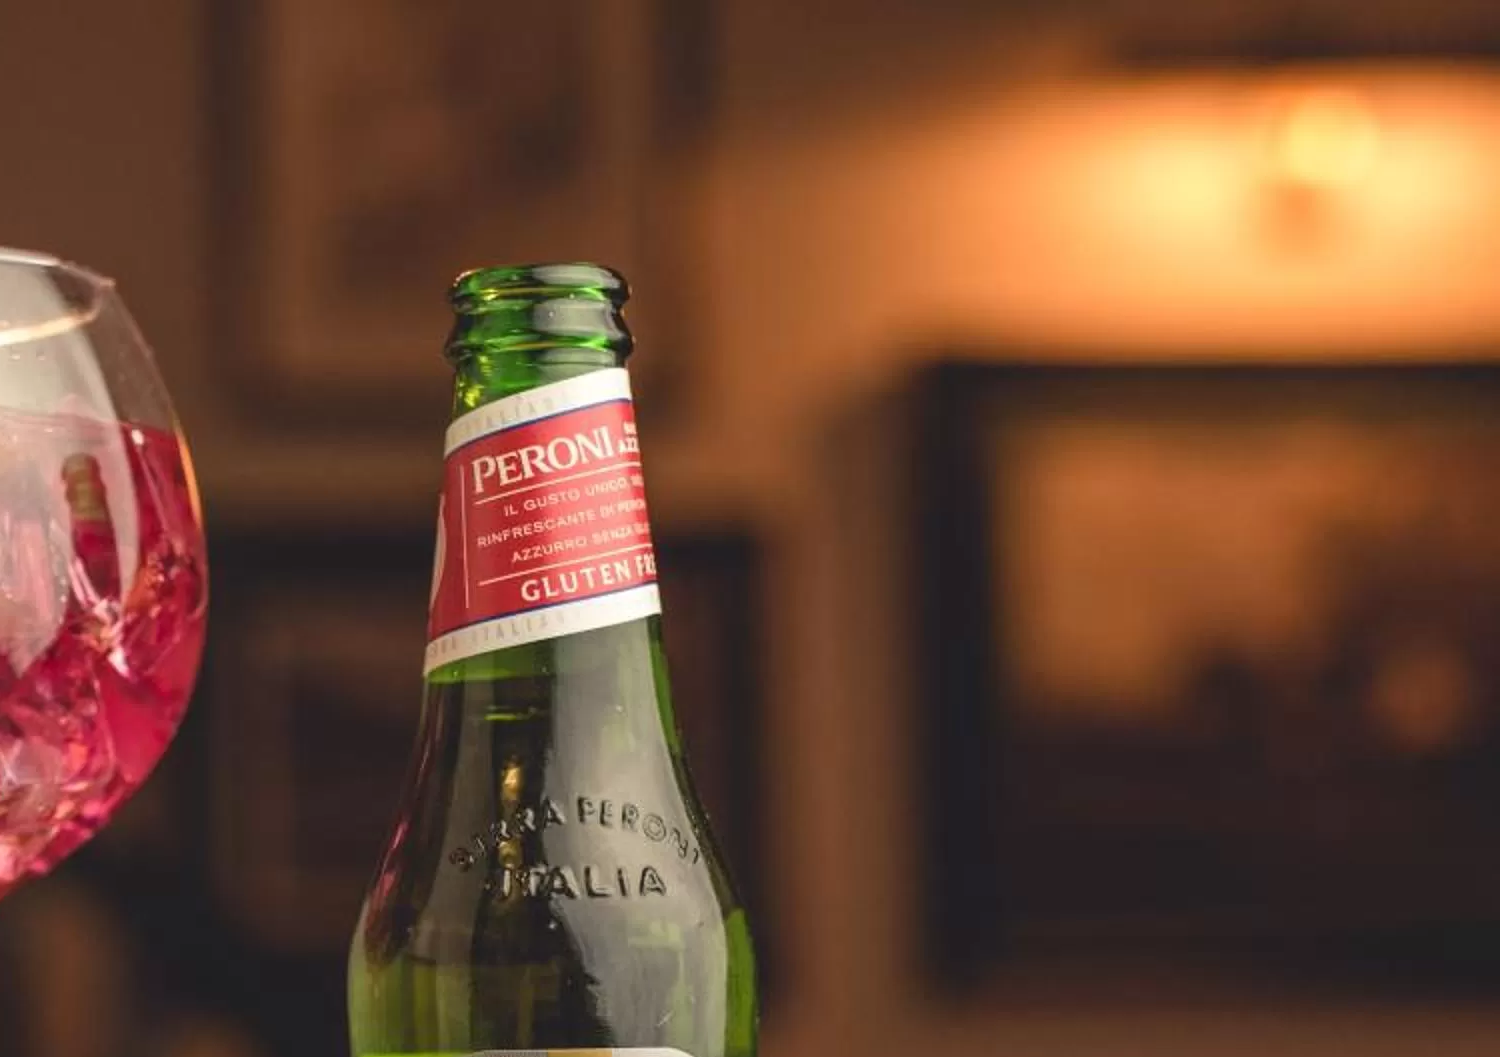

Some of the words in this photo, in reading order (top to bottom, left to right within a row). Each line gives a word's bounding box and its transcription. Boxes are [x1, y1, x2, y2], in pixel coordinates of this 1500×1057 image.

[471, 424, 615, 494] PERONI
[477, 511, 596, 548] RINFRESCANTE
[617, 498, 646, 514] PERO
[504, 503, 519, 516] IL
[524, 489, 580, 512] GUSTO
[512, 535, 588, 564] AZZURRO
[521, 559, 632, 602] GLUTEN
[576, 796, 701, 866] PERONI
[502, 865, 667, 898] ITALIA
